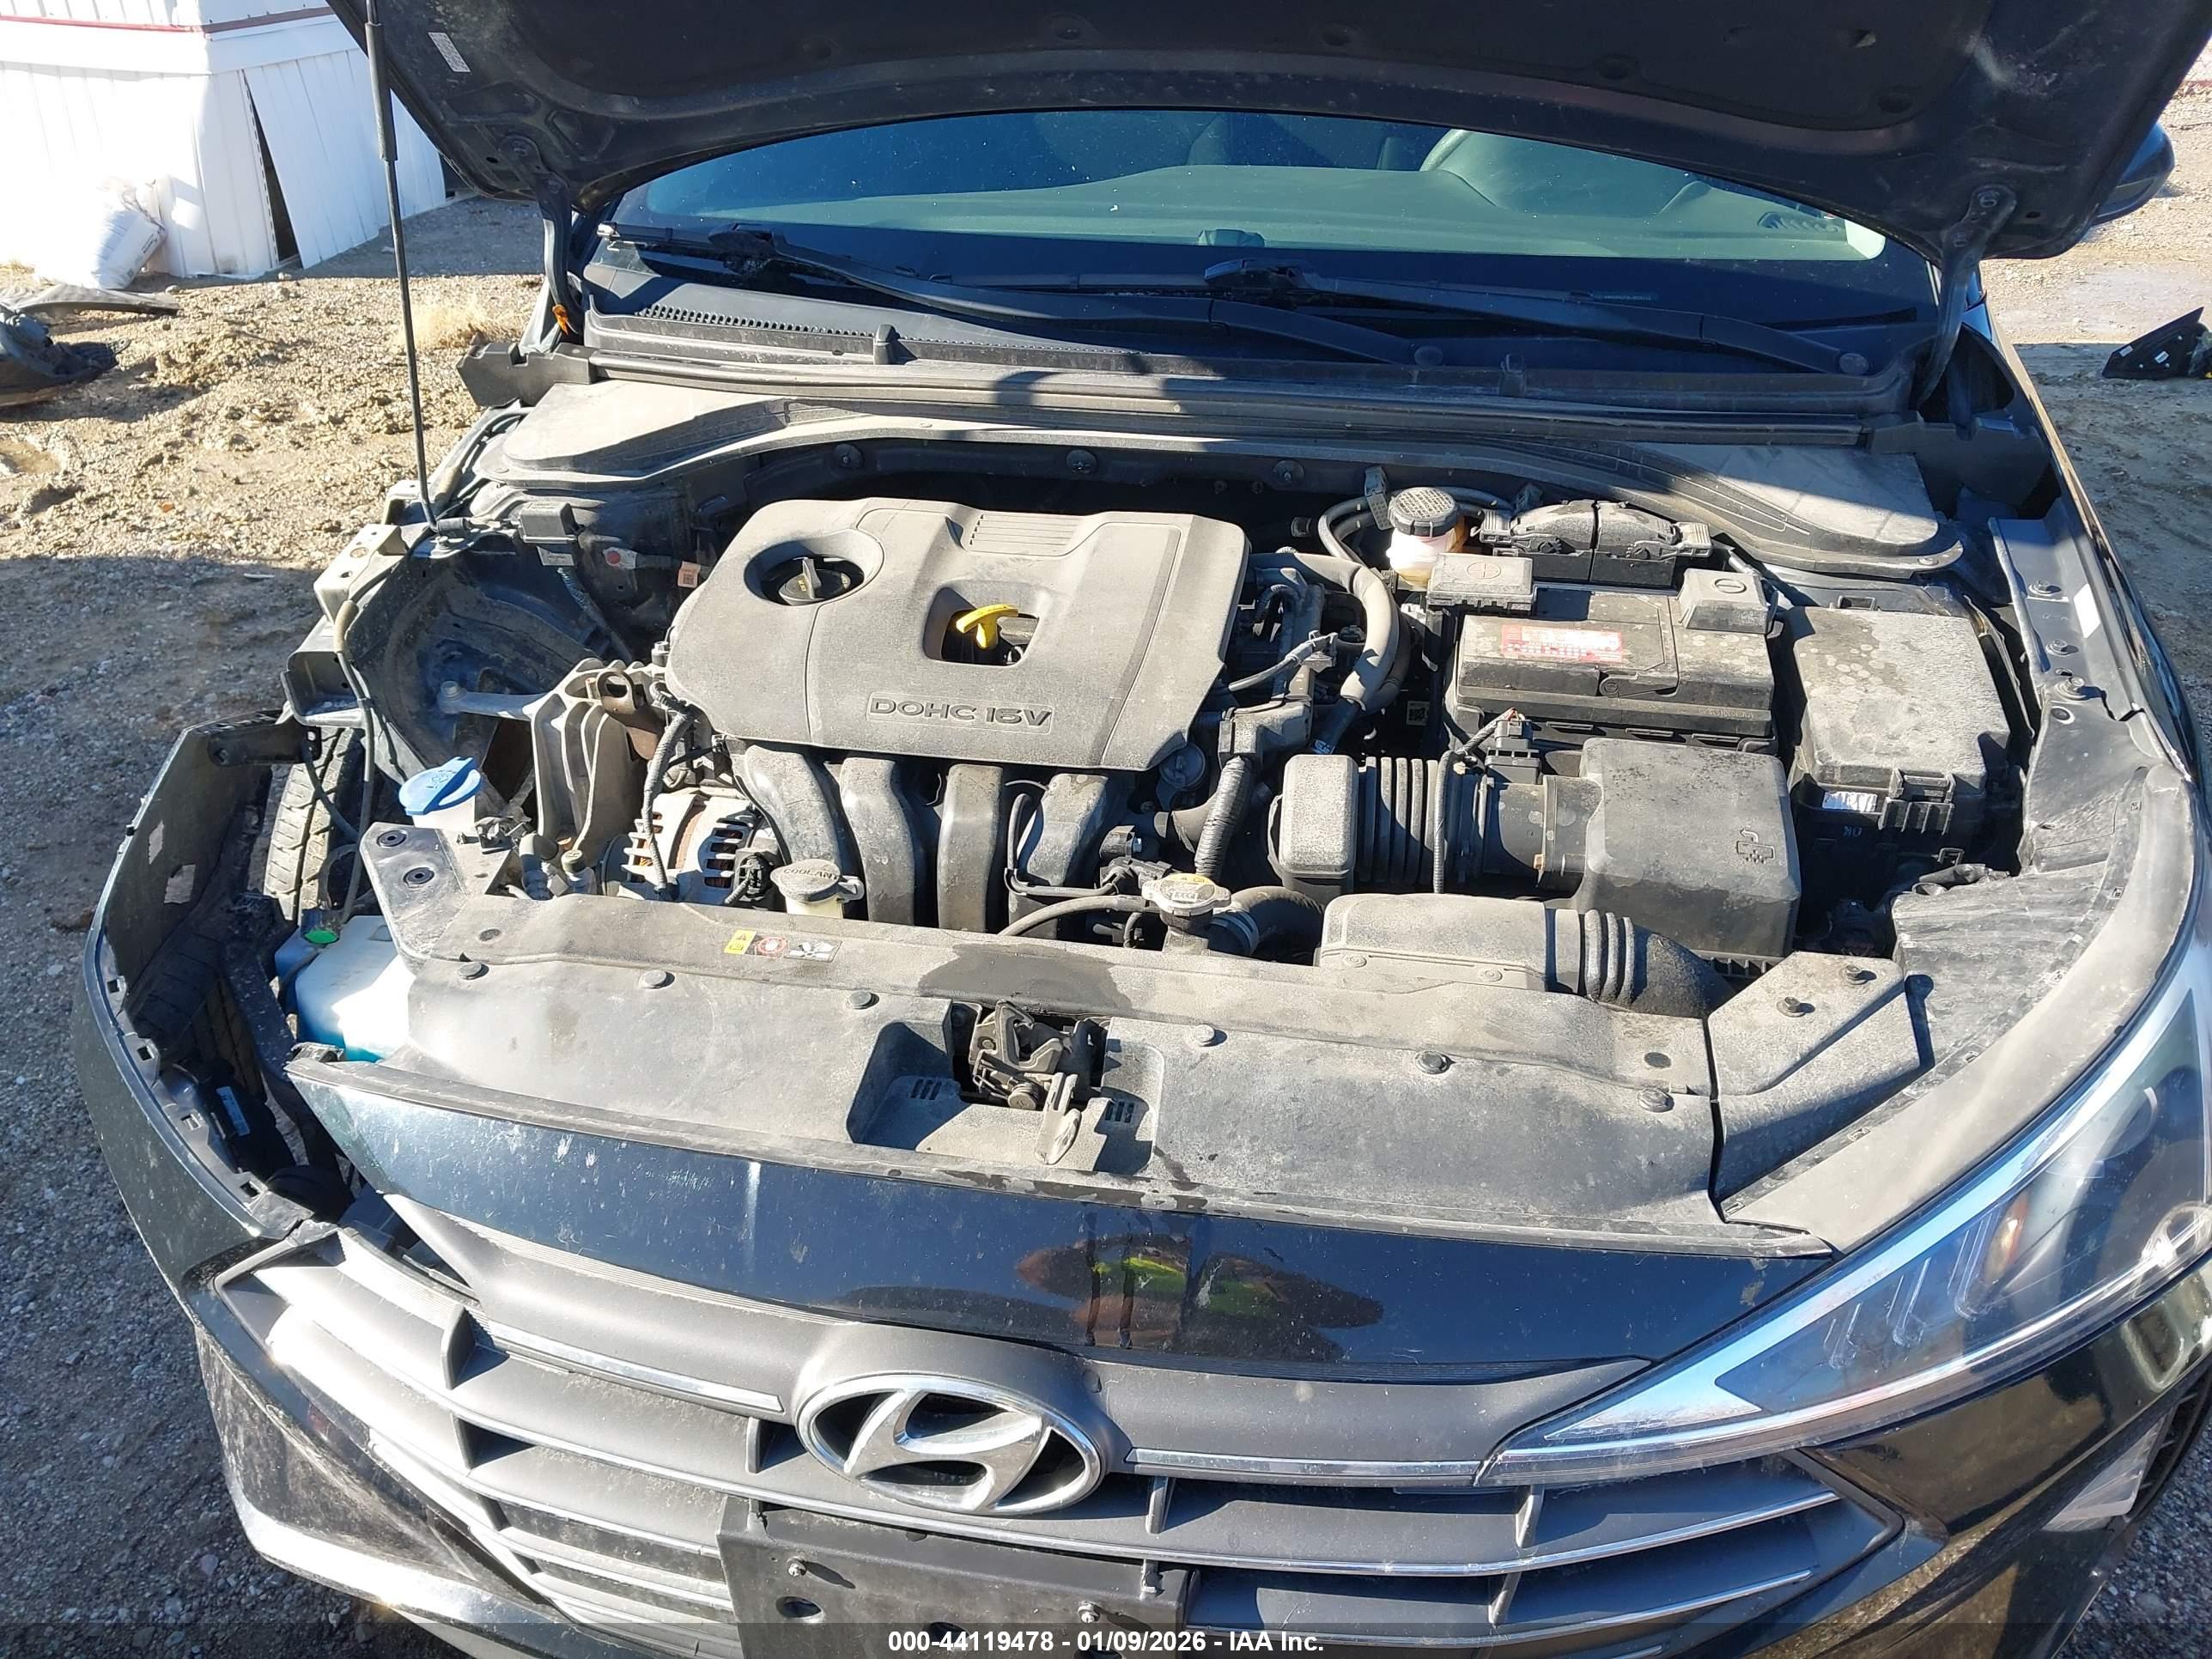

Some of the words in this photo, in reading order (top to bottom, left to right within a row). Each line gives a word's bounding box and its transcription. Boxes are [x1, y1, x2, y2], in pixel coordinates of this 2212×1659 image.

[869, 697, 977, 721] DOHC
[985, 707, 1052, 726] 16V
[783, 867, 839, 880] COOLANT
